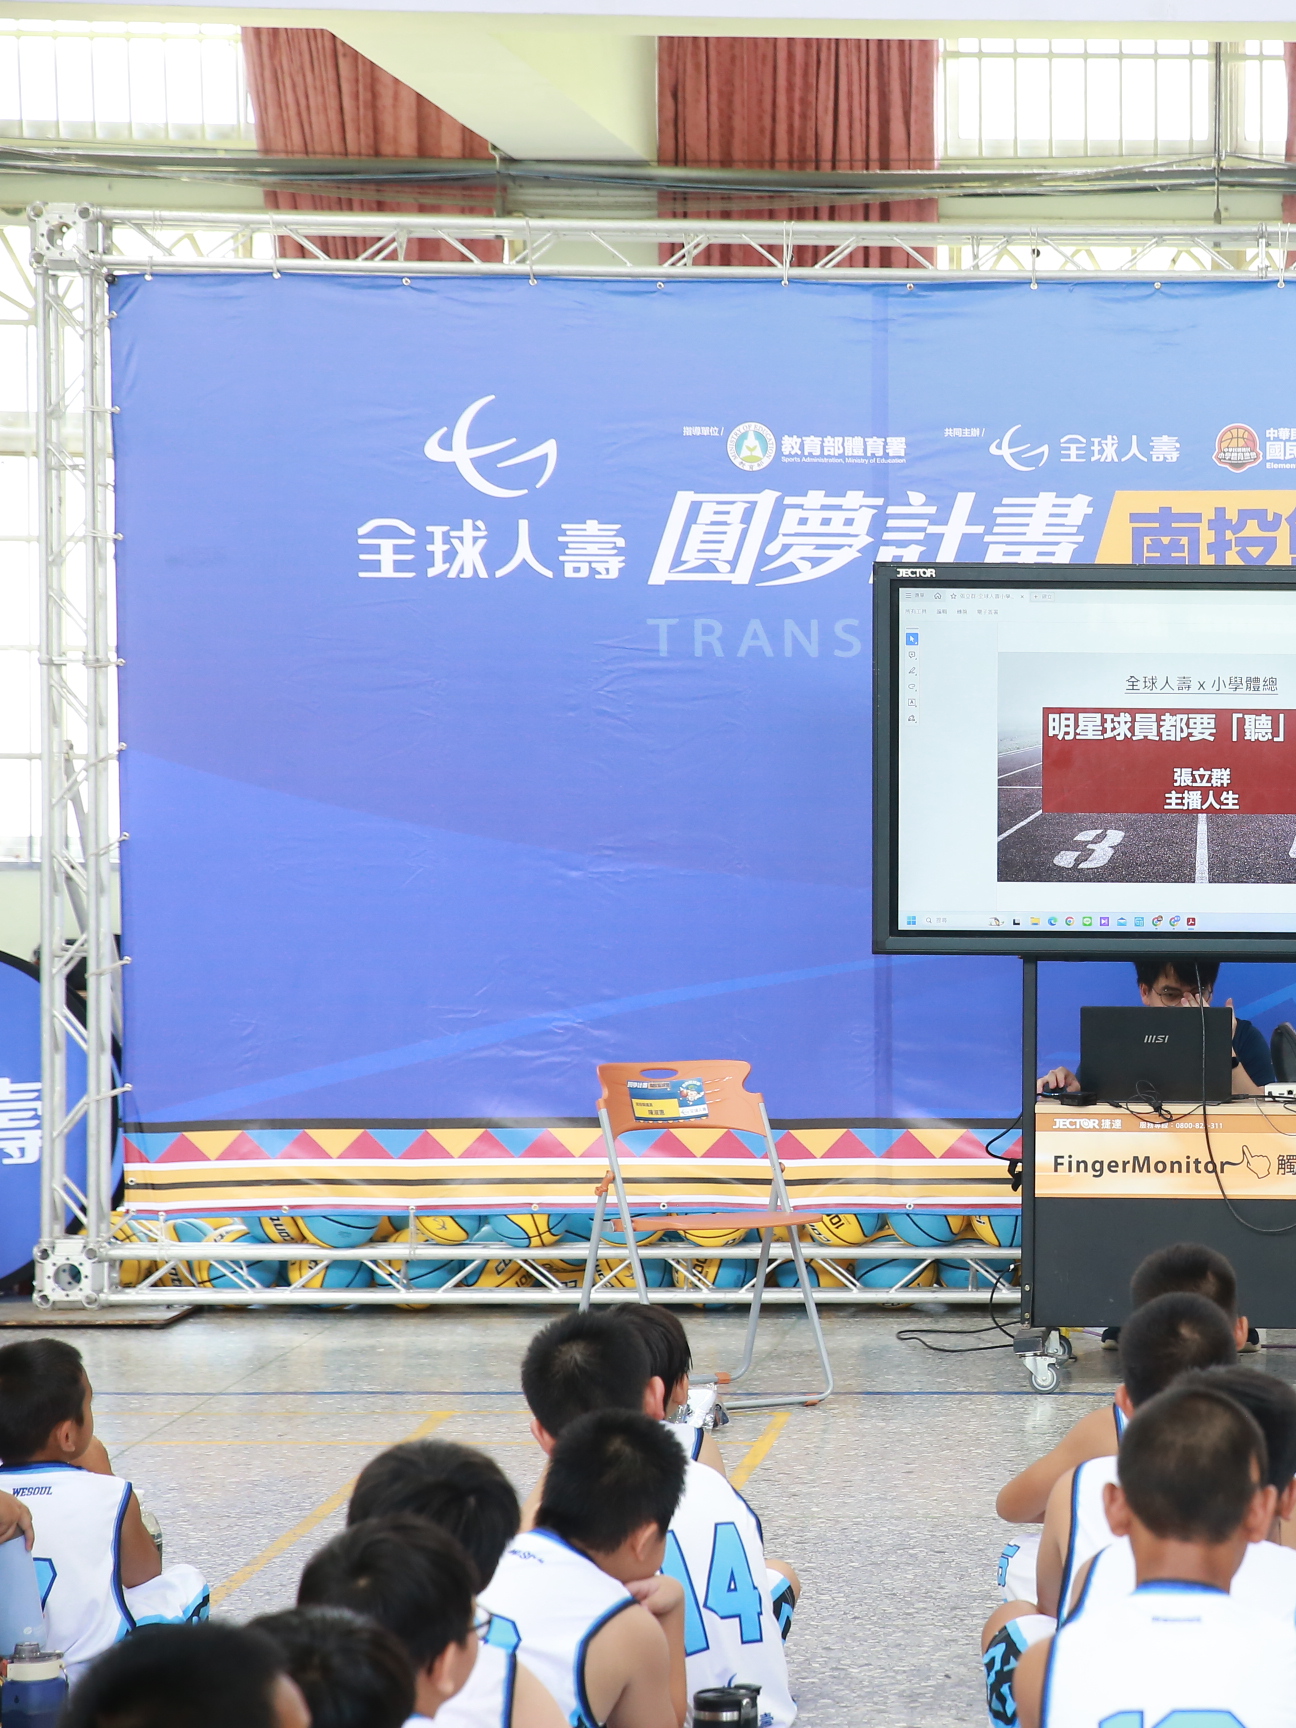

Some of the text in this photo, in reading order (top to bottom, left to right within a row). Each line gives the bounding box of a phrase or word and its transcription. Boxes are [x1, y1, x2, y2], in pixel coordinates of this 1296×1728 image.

[781, 434, 907, 457] 教育部體育署
[1059, 434, 1181, 463] 全球人壽
[781, 456, 801, 464] Sports
[801, 456, 845, 464] Administration,
[845, 457, 868, 465] Ministry
[647, 488, 1094, 587] 圓夢計畫
[356, 517, 627, 581] 全球人壽
[896, 568, 936, 578] JECTOR
[1125, 674, 1192, 692] 全球人壽
[1211, 675, 1278, 693] 小學體總
[1172, 767, 1231, 788] 張立群
[1163, 790, 1240, 811] 主播人生
[1052, 829, 1126, 870] 3
[1052, 1118, 1122, 1130] JECTOR 捷達
[1175, 1122, 1224, 1130] 0800-82-311
[1052, 1154, 1228, 1179] FingerMonitor
[12, 1485, 53, 1498] WESOUL
